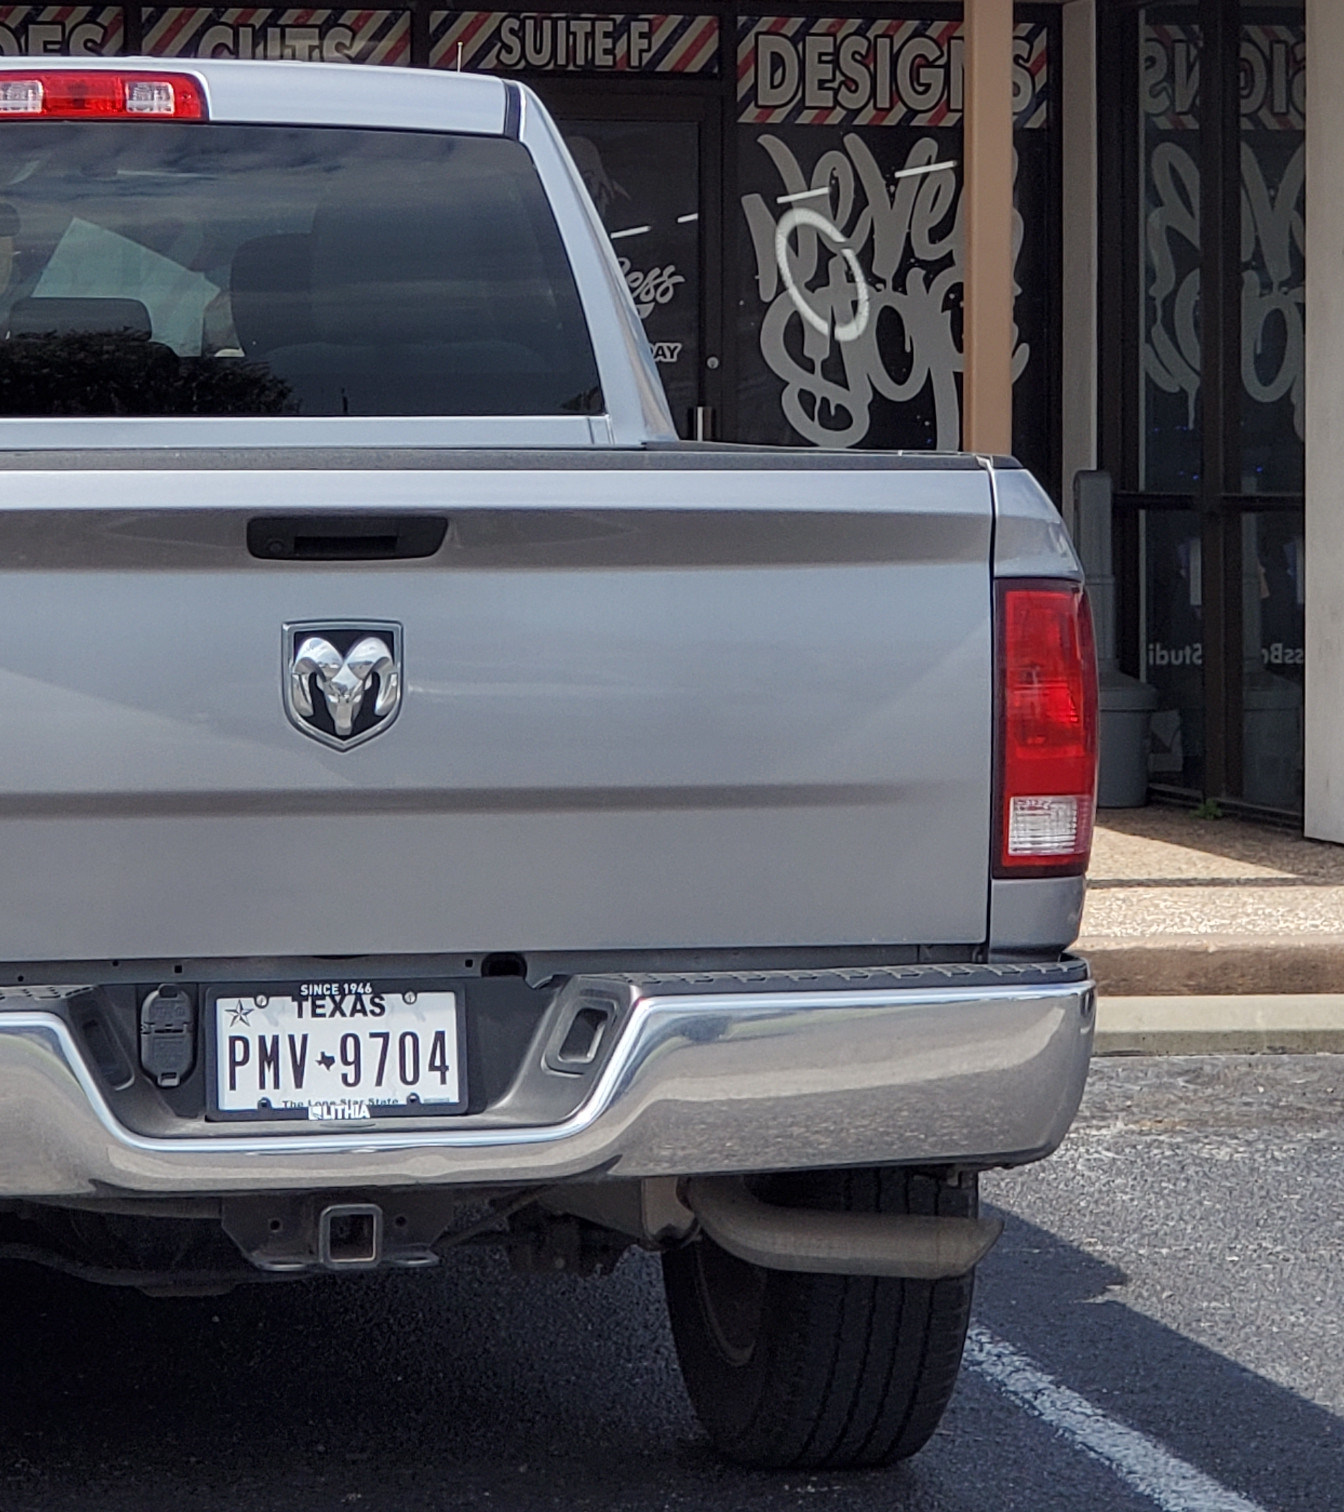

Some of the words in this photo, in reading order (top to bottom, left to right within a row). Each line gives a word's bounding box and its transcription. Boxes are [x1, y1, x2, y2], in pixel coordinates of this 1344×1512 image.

[499, 17, 613, 66] SUITE
[630, 20, 649, 67] F
[300, 984, 339, 996] SINCE
[343, 983, 373, 994] 1946
[292, 994, 386, 1019] TEXAS
[322, 1104, 371, 1120] LITHIA
